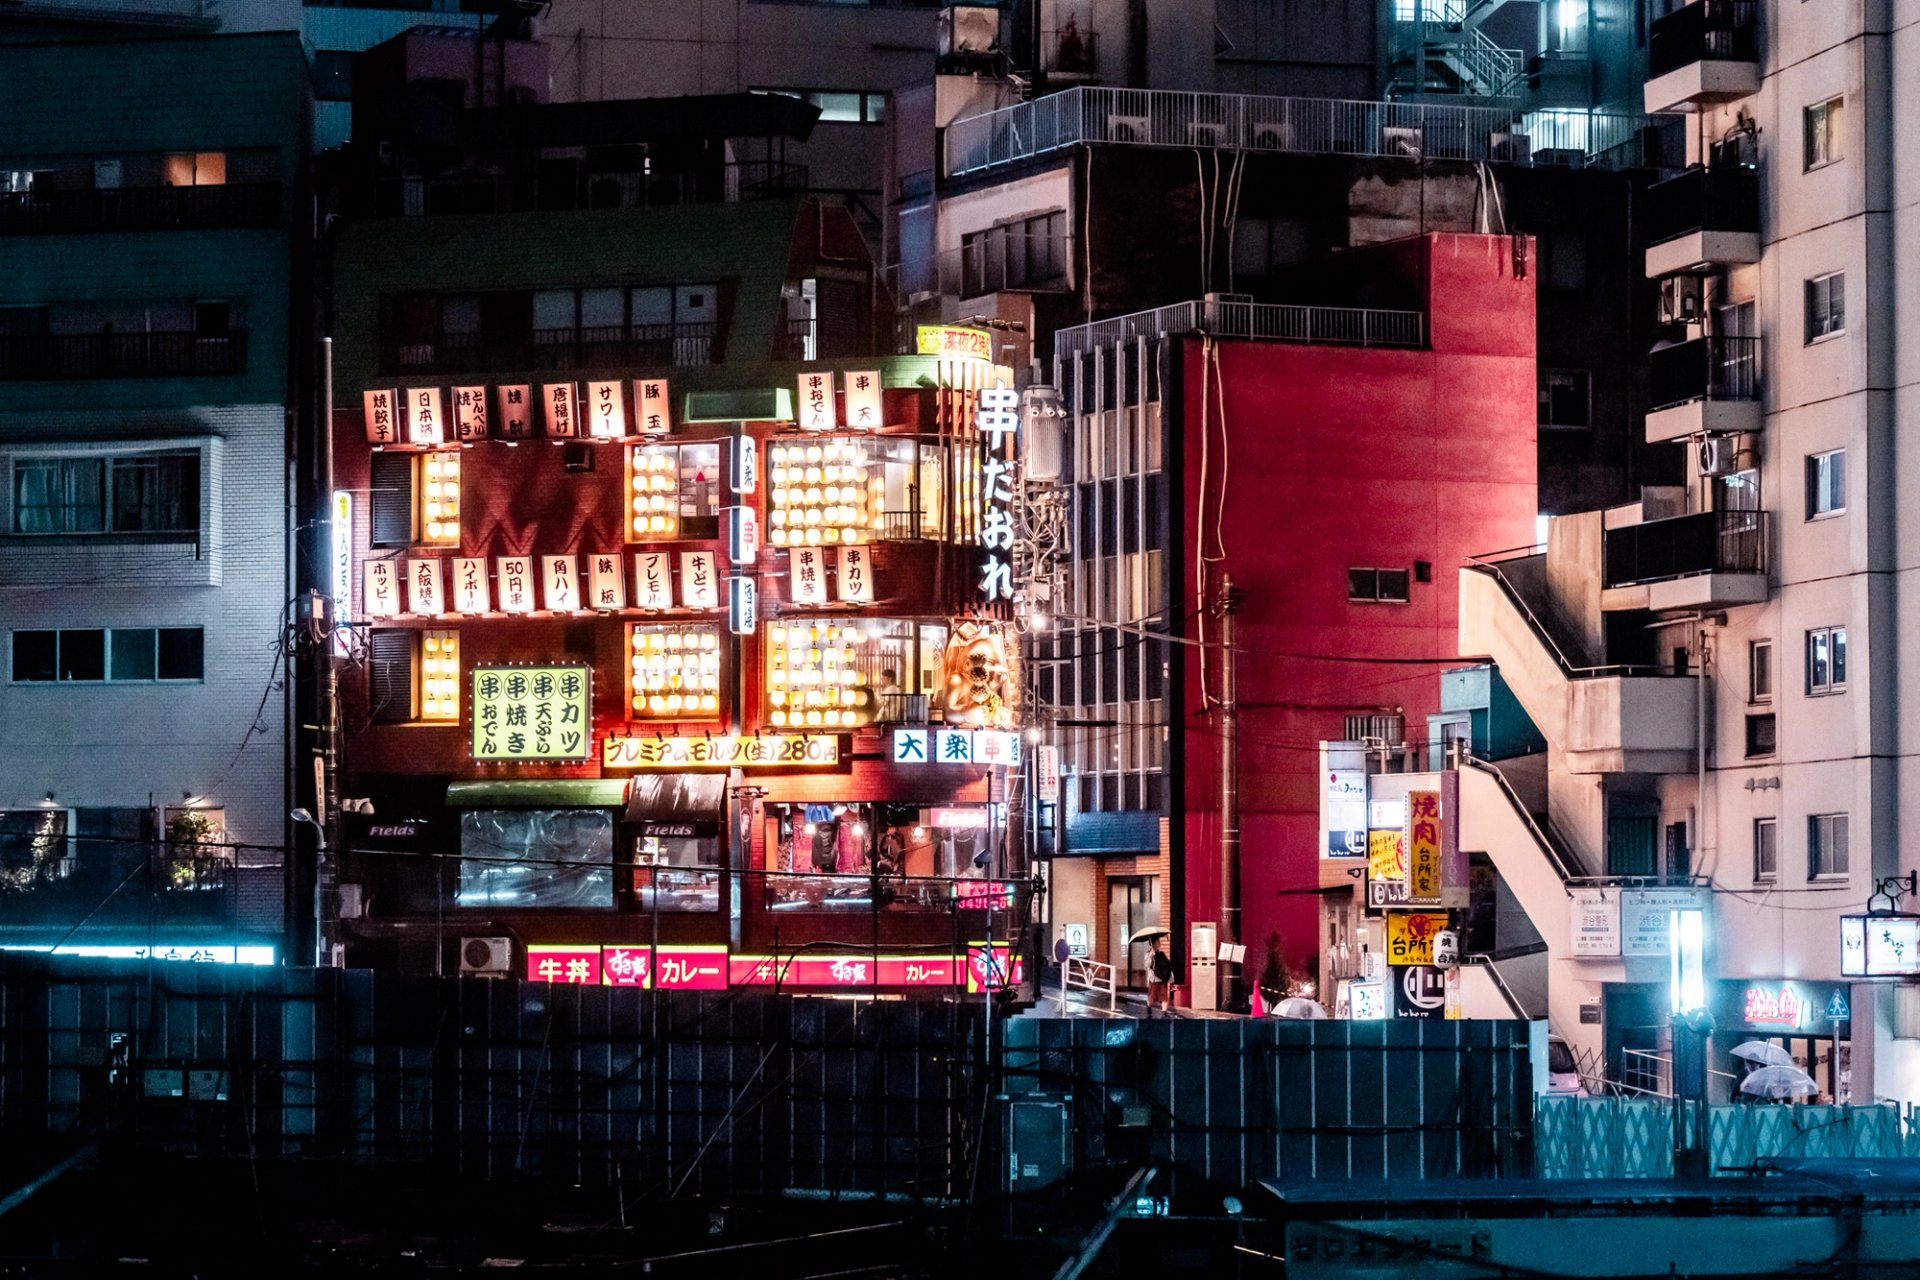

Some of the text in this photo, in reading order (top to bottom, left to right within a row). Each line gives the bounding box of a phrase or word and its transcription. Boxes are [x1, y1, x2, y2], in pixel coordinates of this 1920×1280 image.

[373, 393, 390, 439] 焼餃子
[418, 392, 434, 437] 日本酒
[457, 391, 472, 435] 焼き
[508, 388, 524, 435] 焼酎
[553, 387, 568, 434] 唐揚げ
[600, 386, 613, 431] サワー
[645, 383, 662, 429] 豚玉
[808, 375, 825, 425] 串おでん
[855, 375, 871, 421] 串天
[977, 378, 1019, 600] 串だおれ
[374, 562, 390, 609] ホッピー
[418, 561, 434, 609] 大阪焼き
[463, 559, 478, 609] ハイボール
[505, 561, 524, 605] 50円串
[553, 559, 569, 604] 角ハイ
[598, 557, 616, 605] 鉄板
[645, 554, 662, 604] プレモル
[800, 550, 816, 596] 串焼き
[846, 549, 862, 595] 串カツ
[480, 675, 499, 754] 串おでん
[506, 675, 527, 753] 串焼き
[534, 675, 553, 754] 串天ぷら
[560, 674, 581, 753] 串カツ
[1412, 794, 1438, 847] 焼肉
[1418, 847, 1432, 893] 台所家
[608, 949, 647, 979] すき家
[1392, 935, 1435, 956] 台所
[538, 958, 590, 984] 牛丼
[661, 958, 721, 983] カレー
[830, 958, 867, 984] すき家
[906, 964, 945, 982] カレー
